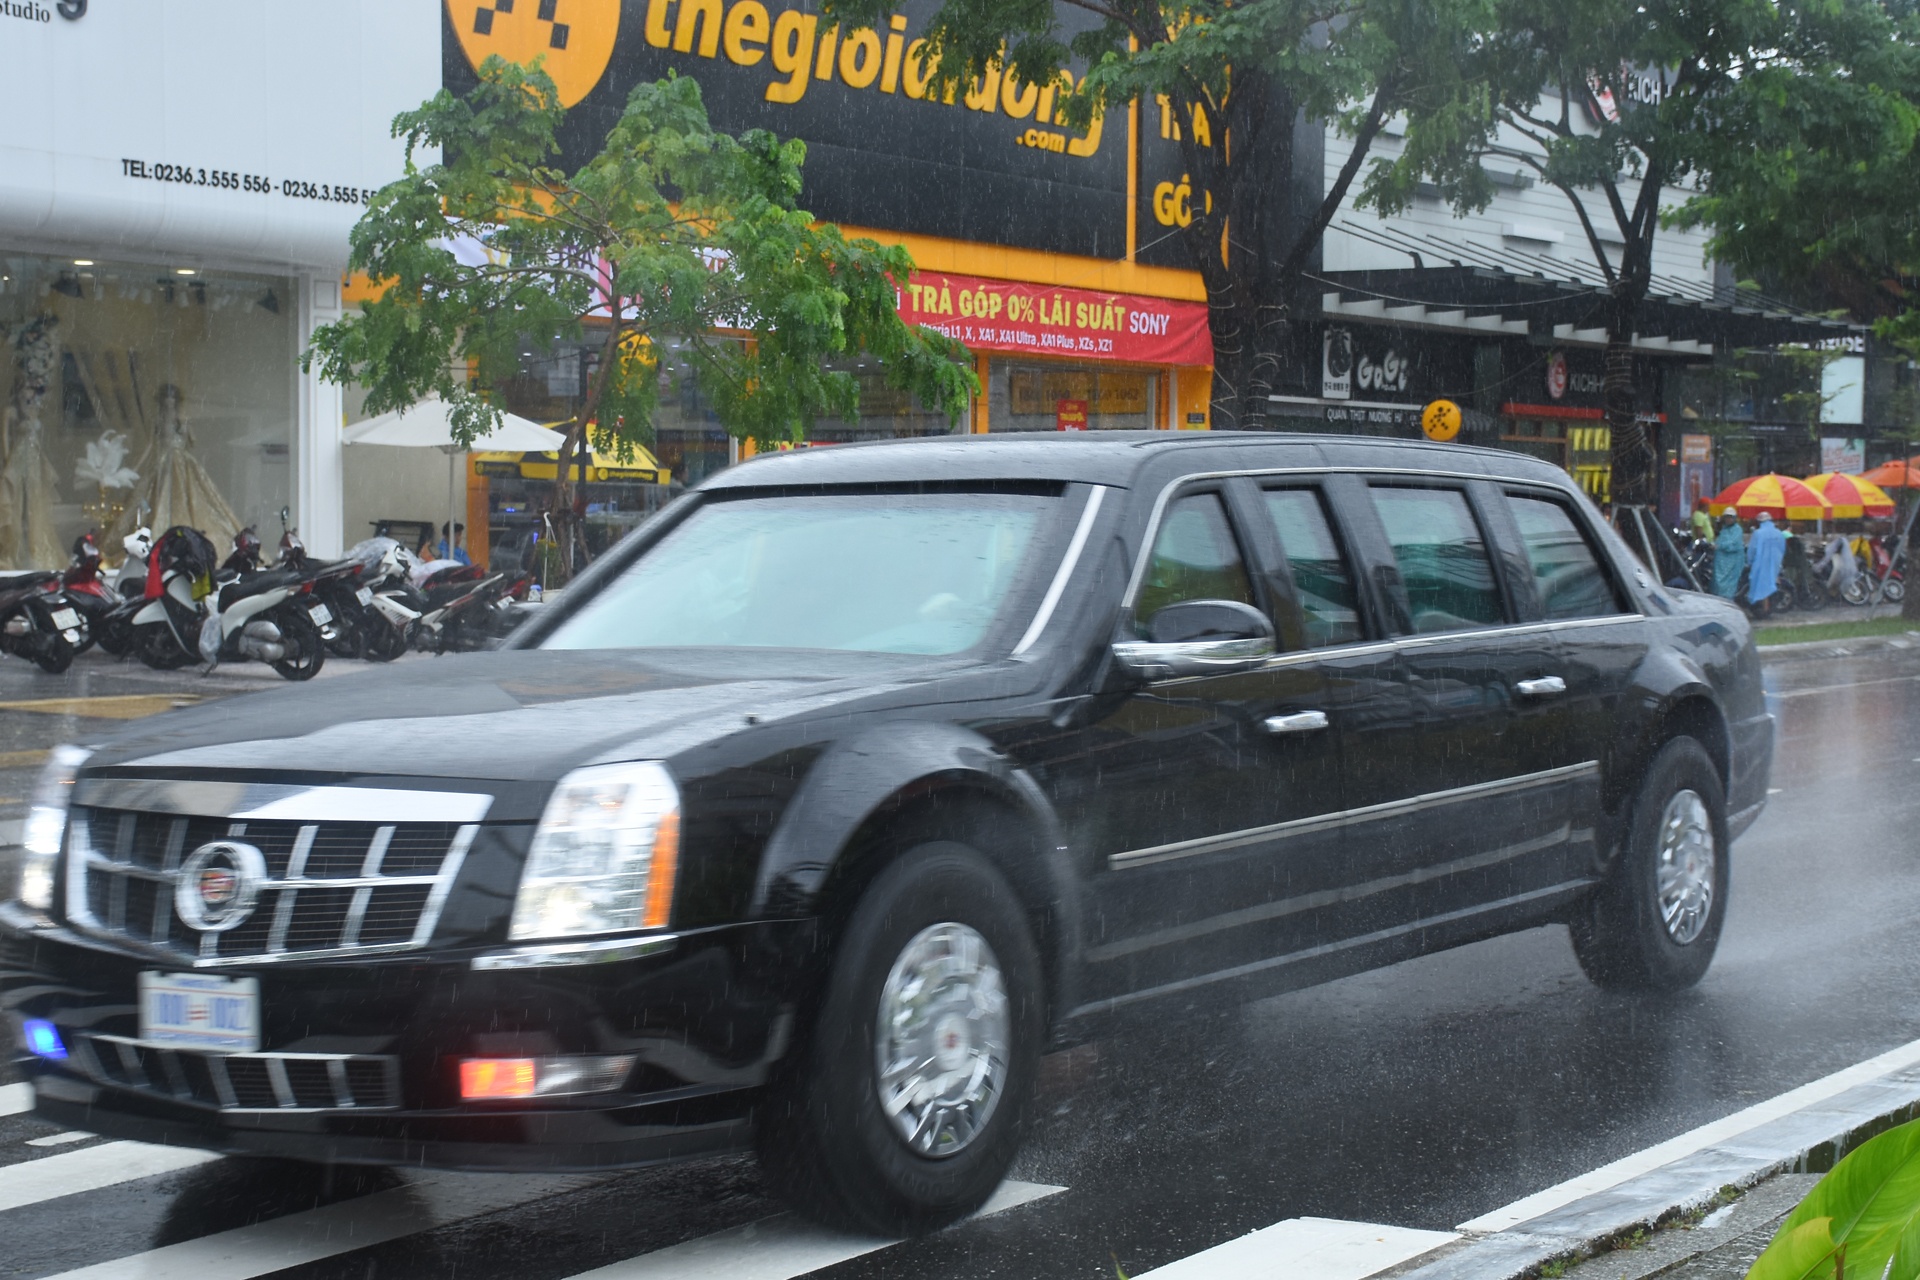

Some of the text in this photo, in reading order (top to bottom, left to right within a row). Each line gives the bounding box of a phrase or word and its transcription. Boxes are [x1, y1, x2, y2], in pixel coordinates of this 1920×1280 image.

[1015, 127, 1066, 153] .com
[243, 174, 270, 194] 556
[909, 278, 953, 315] TRẢ
[959, 285, 1002, 319] GÓP
[1007, 294, 1035, 323] 0%
[1039, 294, 1071, 327] LÃI
[1076, 296, 1126, 331] SUẤT
[1129, 310, 1170, 336] SONY
[1000, 329, 1015, 343] XA1
[1041, 333, 1056, 347] XA1
[1098, 338, 1113, 352] XZ1
